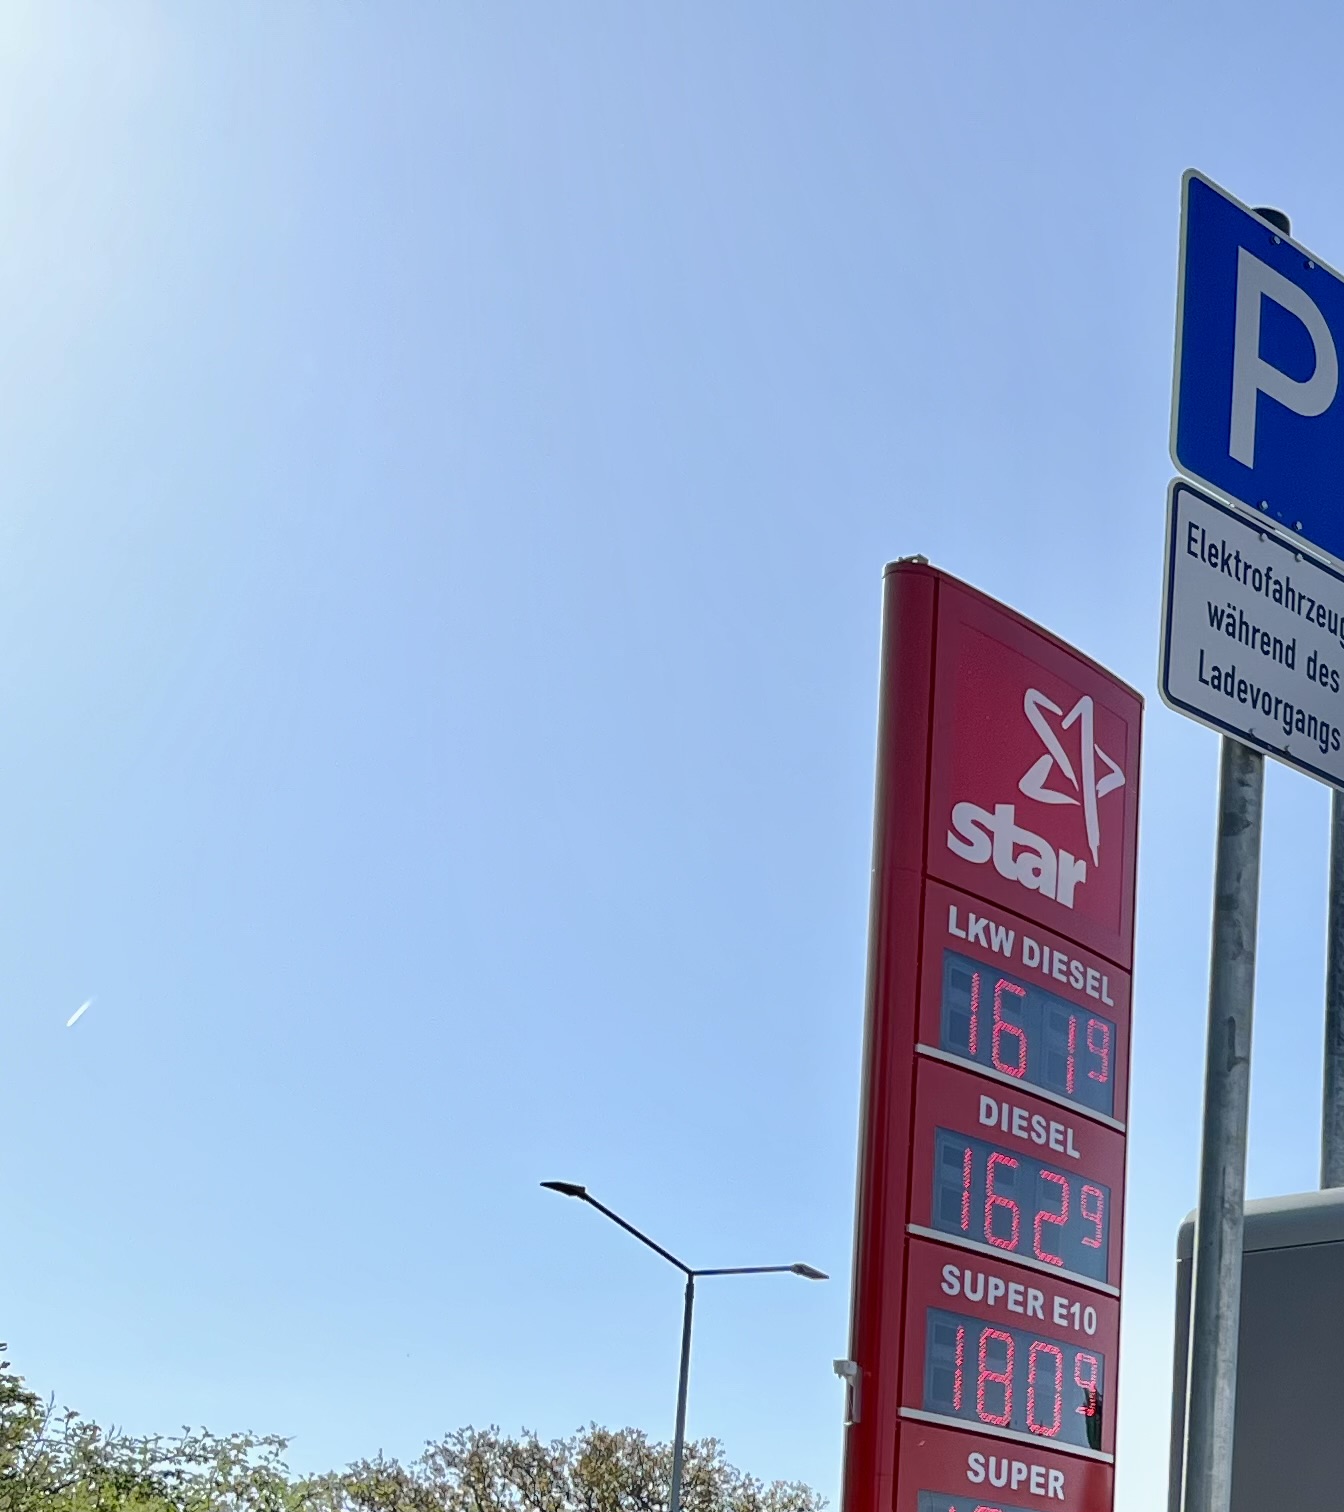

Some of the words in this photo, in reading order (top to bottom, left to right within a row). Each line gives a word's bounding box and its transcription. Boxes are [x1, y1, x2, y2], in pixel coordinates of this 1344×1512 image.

[1229, 245, 1340, 470] P
[1207, 601, 1297, 671] während
[1306, 650, 1341, 694] des
[1198, 648, 1341, 754] Ladevorgangs
[947, 801, 1087, 909] star
[948, 904, 1015, 958] LKW
[1022, 935, 1114, 1007] DIESEL
[978, 1094, 1081, 1160] DIESEL
[940, 1264, 1045, 1321] SUPER
[1053, 1295, 1097, 1336] E10
[966, 1452, 1065, 1501] SUPER
